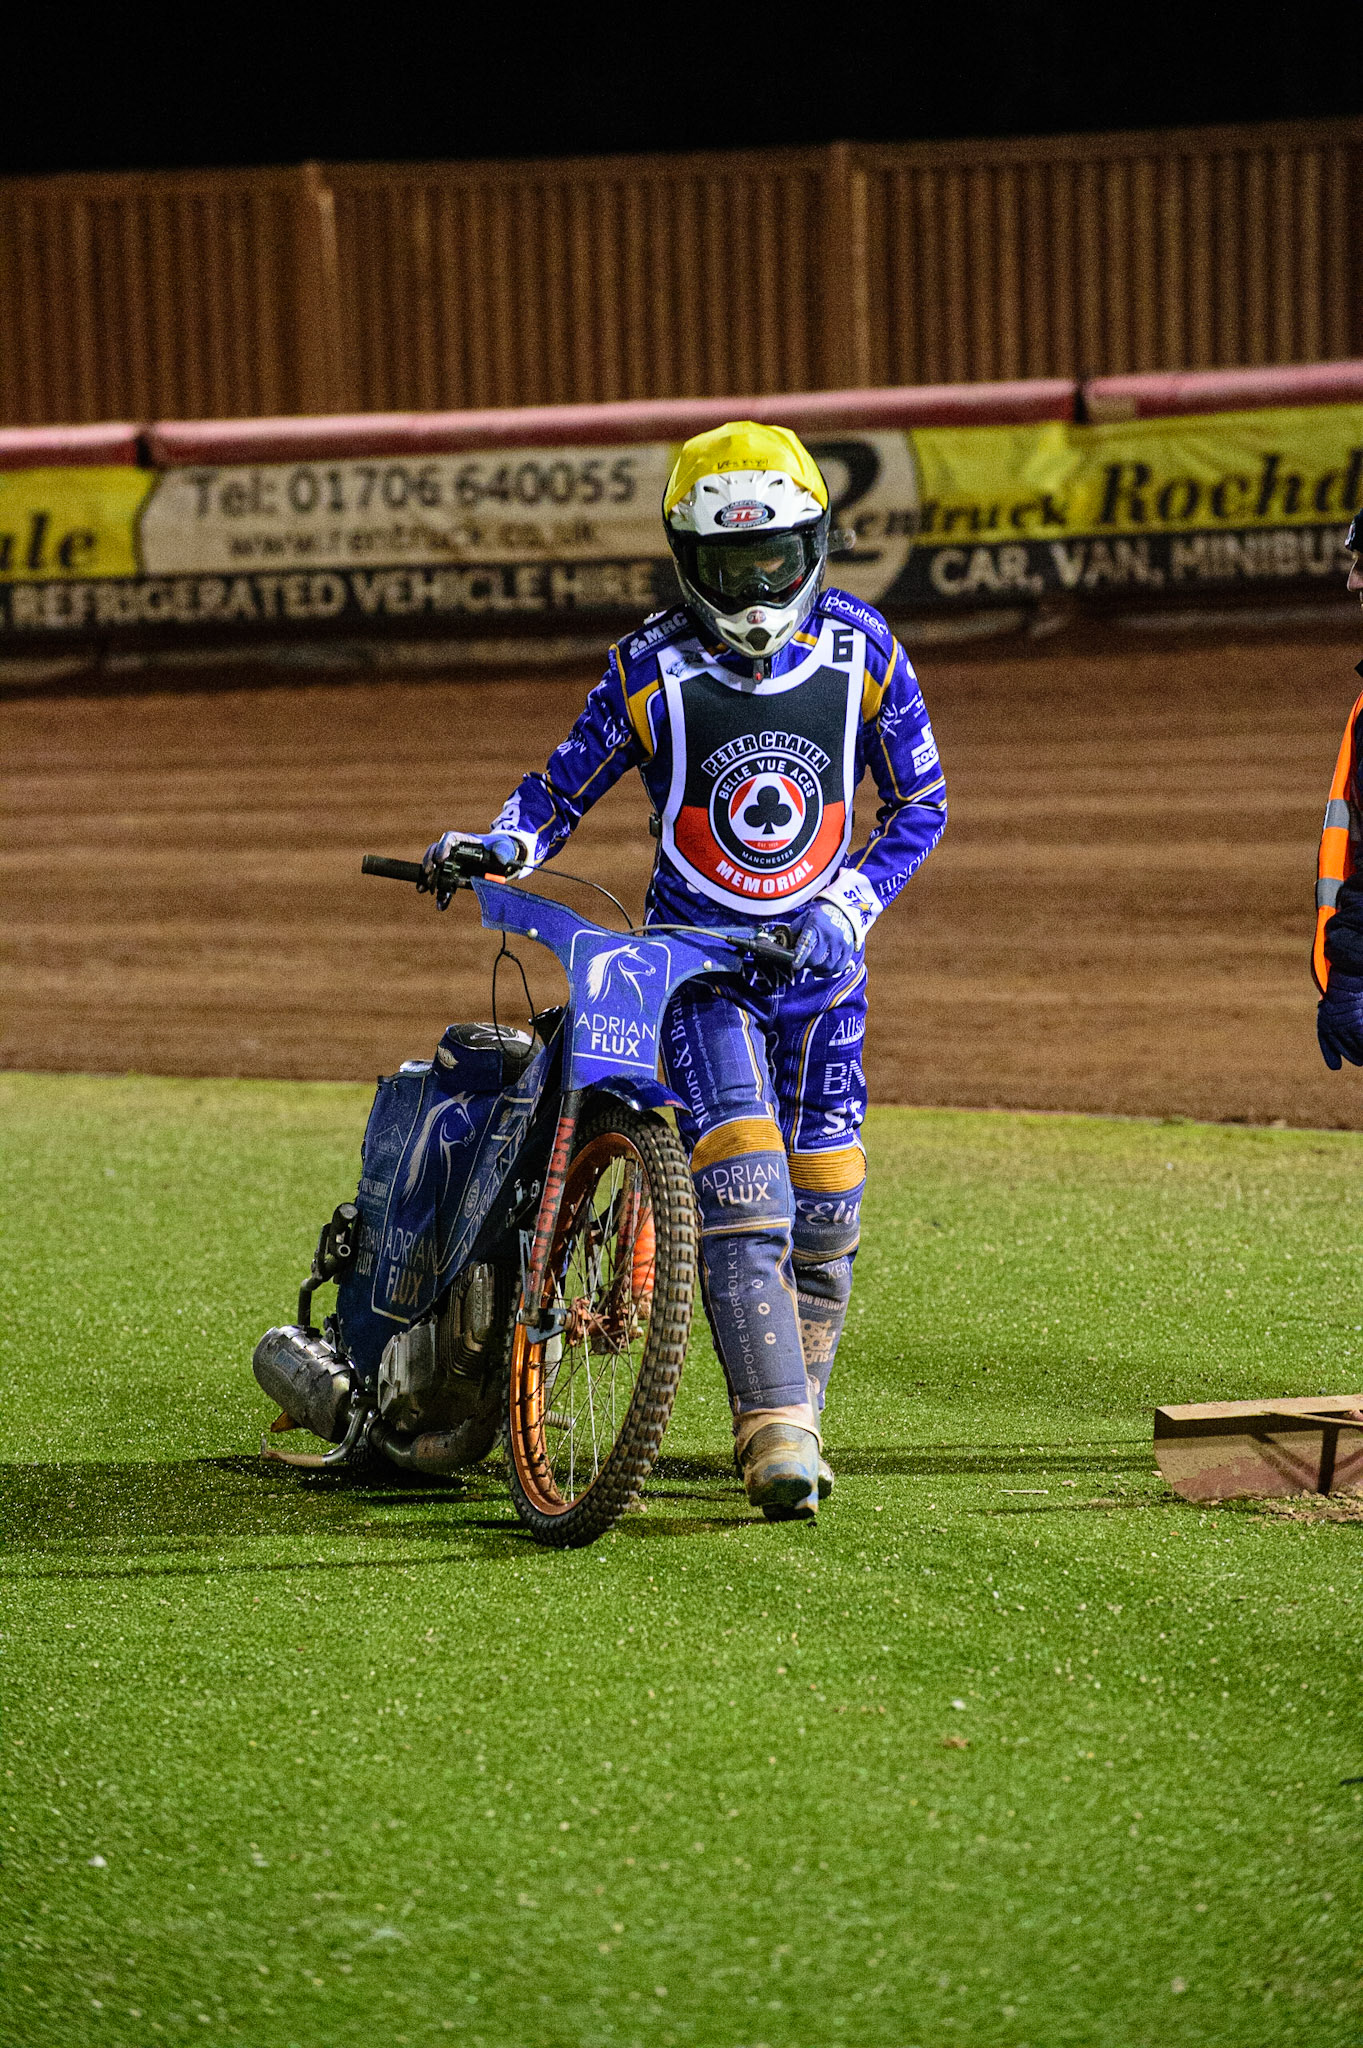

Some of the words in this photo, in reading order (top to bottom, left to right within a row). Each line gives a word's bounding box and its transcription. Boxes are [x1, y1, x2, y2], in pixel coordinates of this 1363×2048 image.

[184, 465, 277, 518] Tel:
[286, 462, 442, 515] 01706
[454, 456, 638, 505] 640055
[725, 508, 764, 520] STS
[11, 574, 347, 630] REFRIGERATED
[352, 566, 546, 614] VEHICLE
[551, 561, 656, 608] HIRE
[643, 611, 688, 644] MRC
[825, 595, 889, 636] poultec
[831, 628, 853, 663] 6
[701, 733, 759, 777] PETER
[759, 730, 831, 773] CRAVEN
[718, 765, 752, 800] BELLE
[756, 759, 787, 772] VUE
[789, 767, 816, 798] ACES
[741, 849, 794, 864] MANCHESTER
[715, 859, 814, 894] MEMORIAL
[575, 1011, 656, 1041] ADRIAN
[591, 1031, 640, 1058] FLUX
[672, 1042, 692, 1069] &
[701, 1162, 781, 1193] ADRIAN
[716, 1182, 771, 1207] FLUX
[383, 1225, 439, 1273] ADRIAN
[728, 1240, 738, 1258] LT
[386, 1264, 424, 1307] FLUX
[728, 1260, 747, 1329] NORFOLK
[813, 1296, 845, 1311] BISHOP
[739, 1333, 763, 1404] BESPOKE
